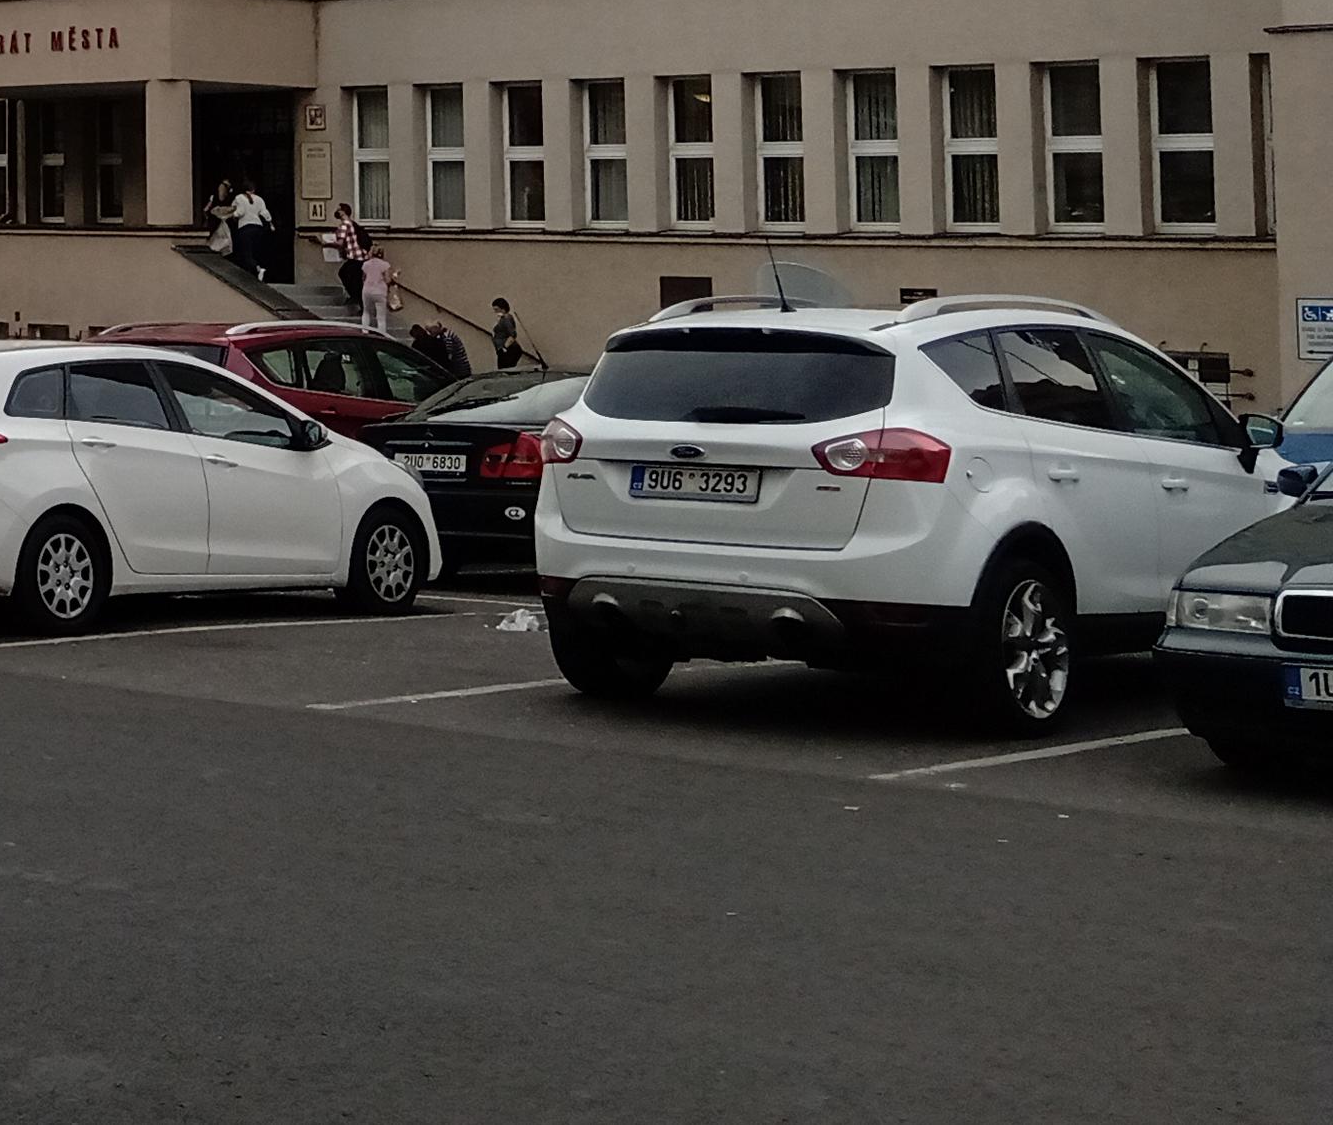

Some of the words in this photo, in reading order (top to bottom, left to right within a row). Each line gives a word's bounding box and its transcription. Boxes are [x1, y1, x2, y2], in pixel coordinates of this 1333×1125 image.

[50, 26, 120, 52] MĚSTA
[312, 204, 323, 217] A1
[432, 456, 461, 470] 6830
[648, 469, 683, 491] 9U6
[698, 472, 748, 494] 3293
